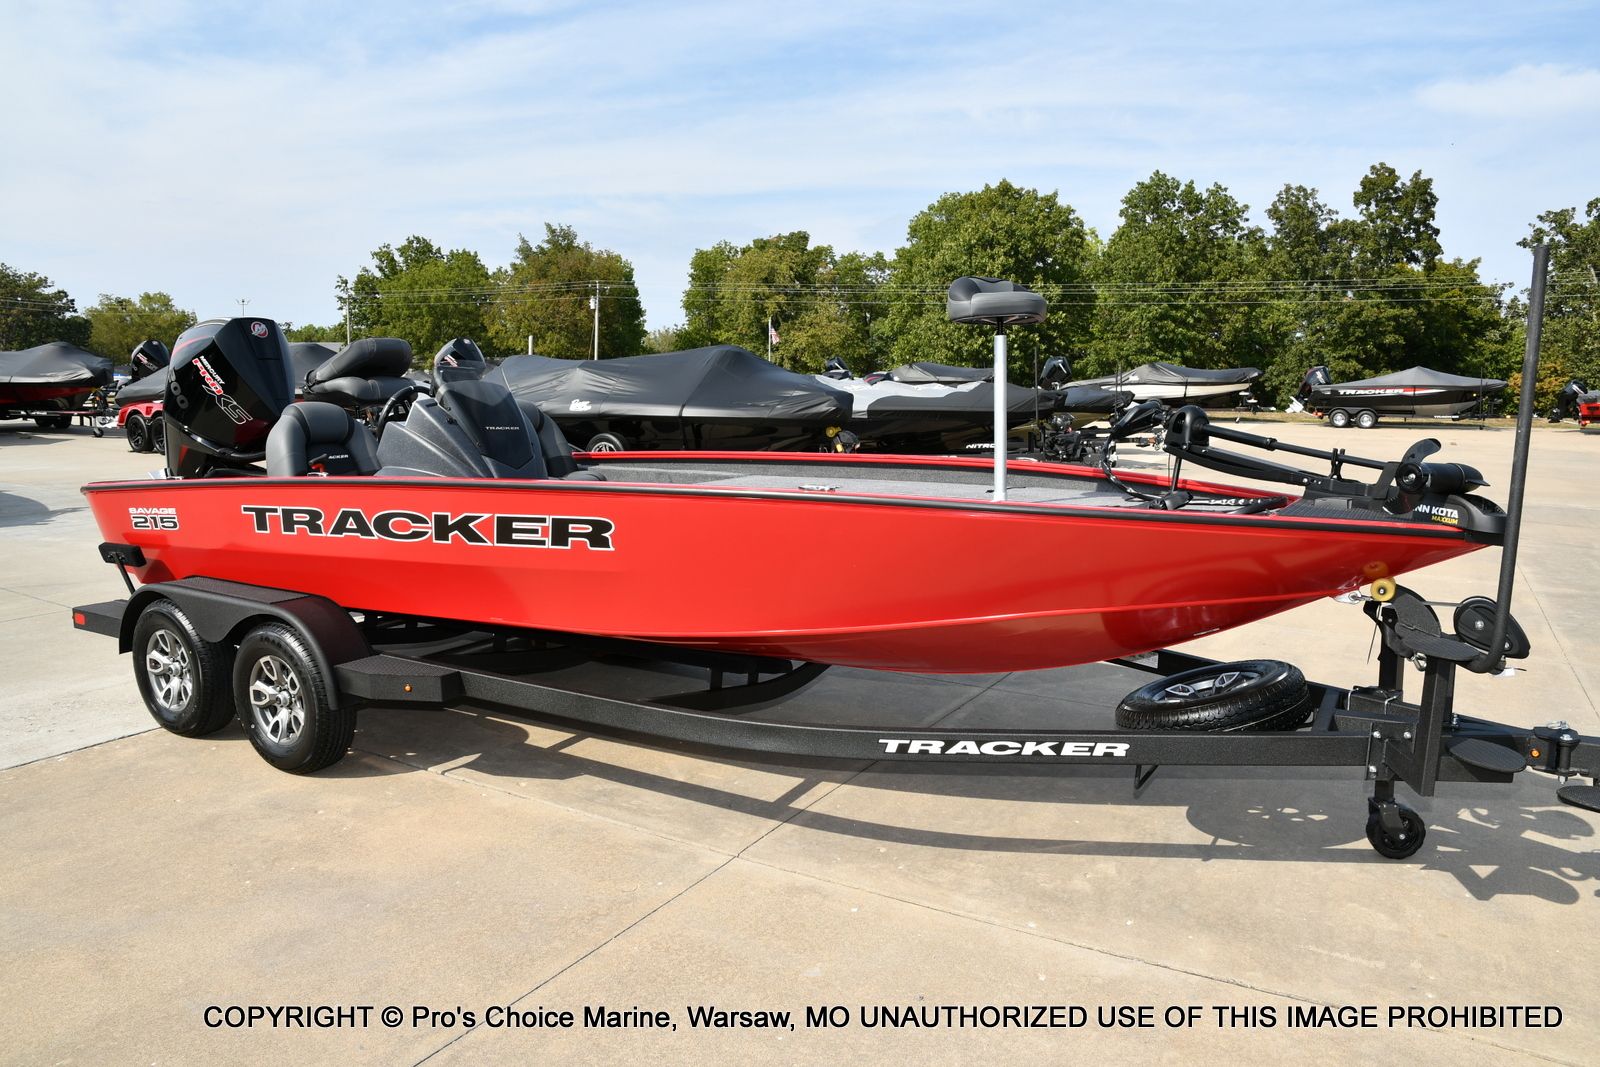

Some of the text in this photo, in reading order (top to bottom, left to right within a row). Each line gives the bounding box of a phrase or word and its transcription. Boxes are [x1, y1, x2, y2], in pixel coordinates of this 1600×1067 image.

[199, 355, 226, 385] MERCURY
[1338, 388, 1405, 396] TRACKER
[202, 385, 254, 425] XS
[1431, 505, 1459, 518] KOTA
[1431, 515, 1459, 525] MAXXUM
[131, 514, 180, 530] 215
[241, 505, 615, 551] TRACKER
[878, 738, 1130, 757] TRACKER
